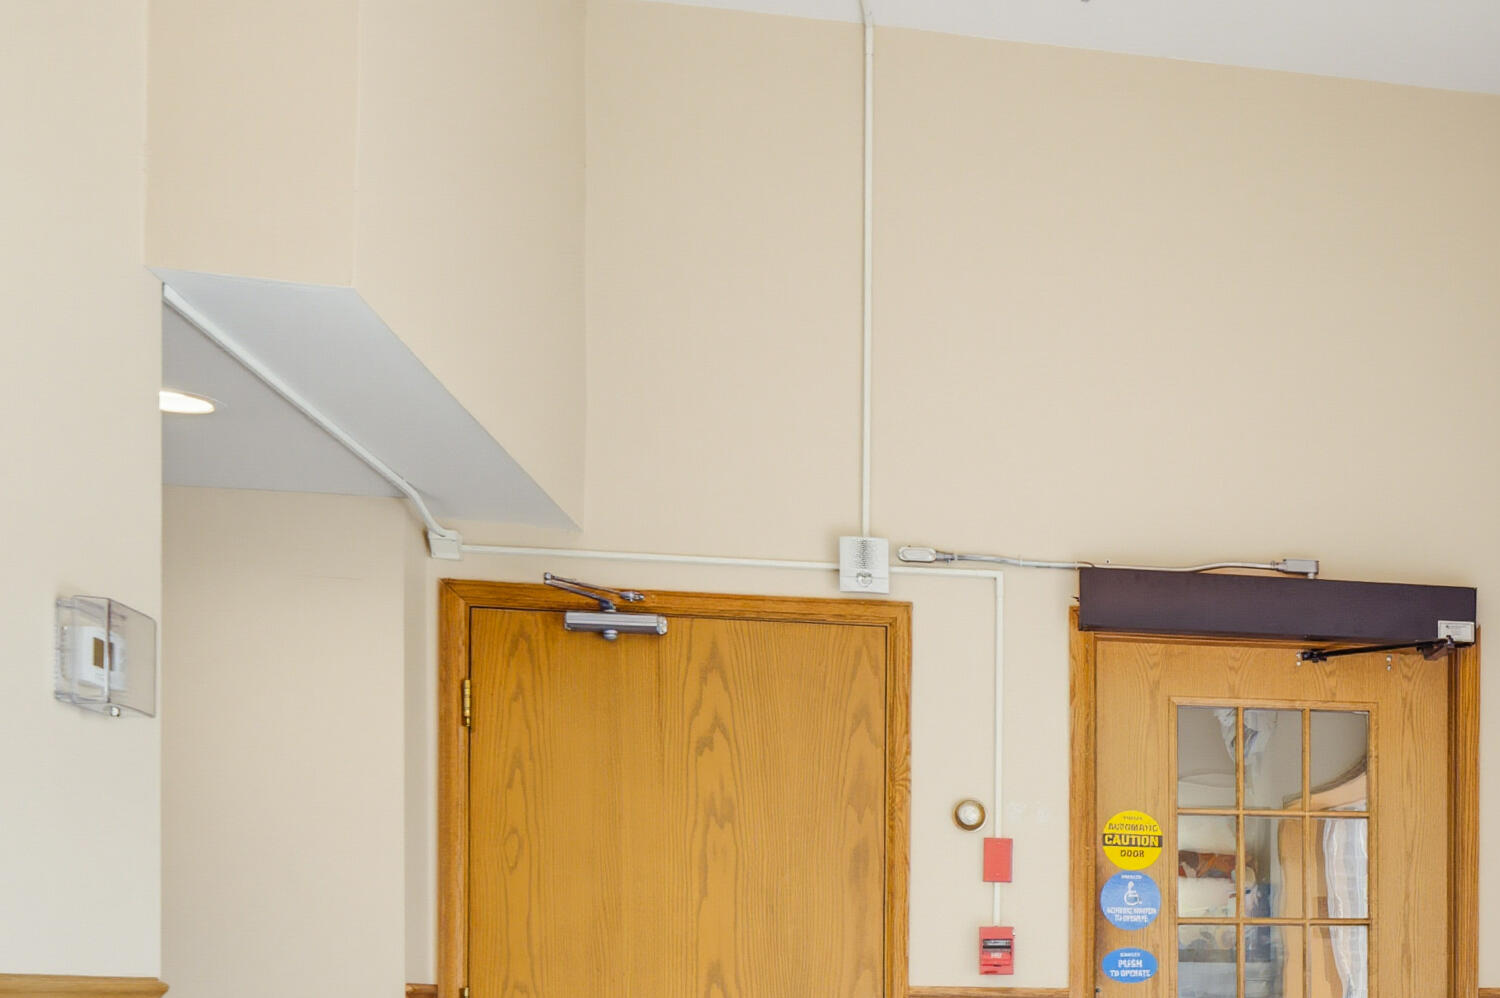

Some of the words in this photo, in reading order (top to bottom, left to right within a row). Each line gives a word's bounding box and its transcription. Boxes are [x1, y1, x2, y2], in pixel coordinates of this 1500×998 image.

[1108, 823, 1158, 832] AUTOMATIC
[1104, 834, 1159, 847] CAUTION
[1120, 849, 1145, 857] DOOR
[1118, 959, 1143, 968] PUSH
[1109, 969, 1120, 977] TO
